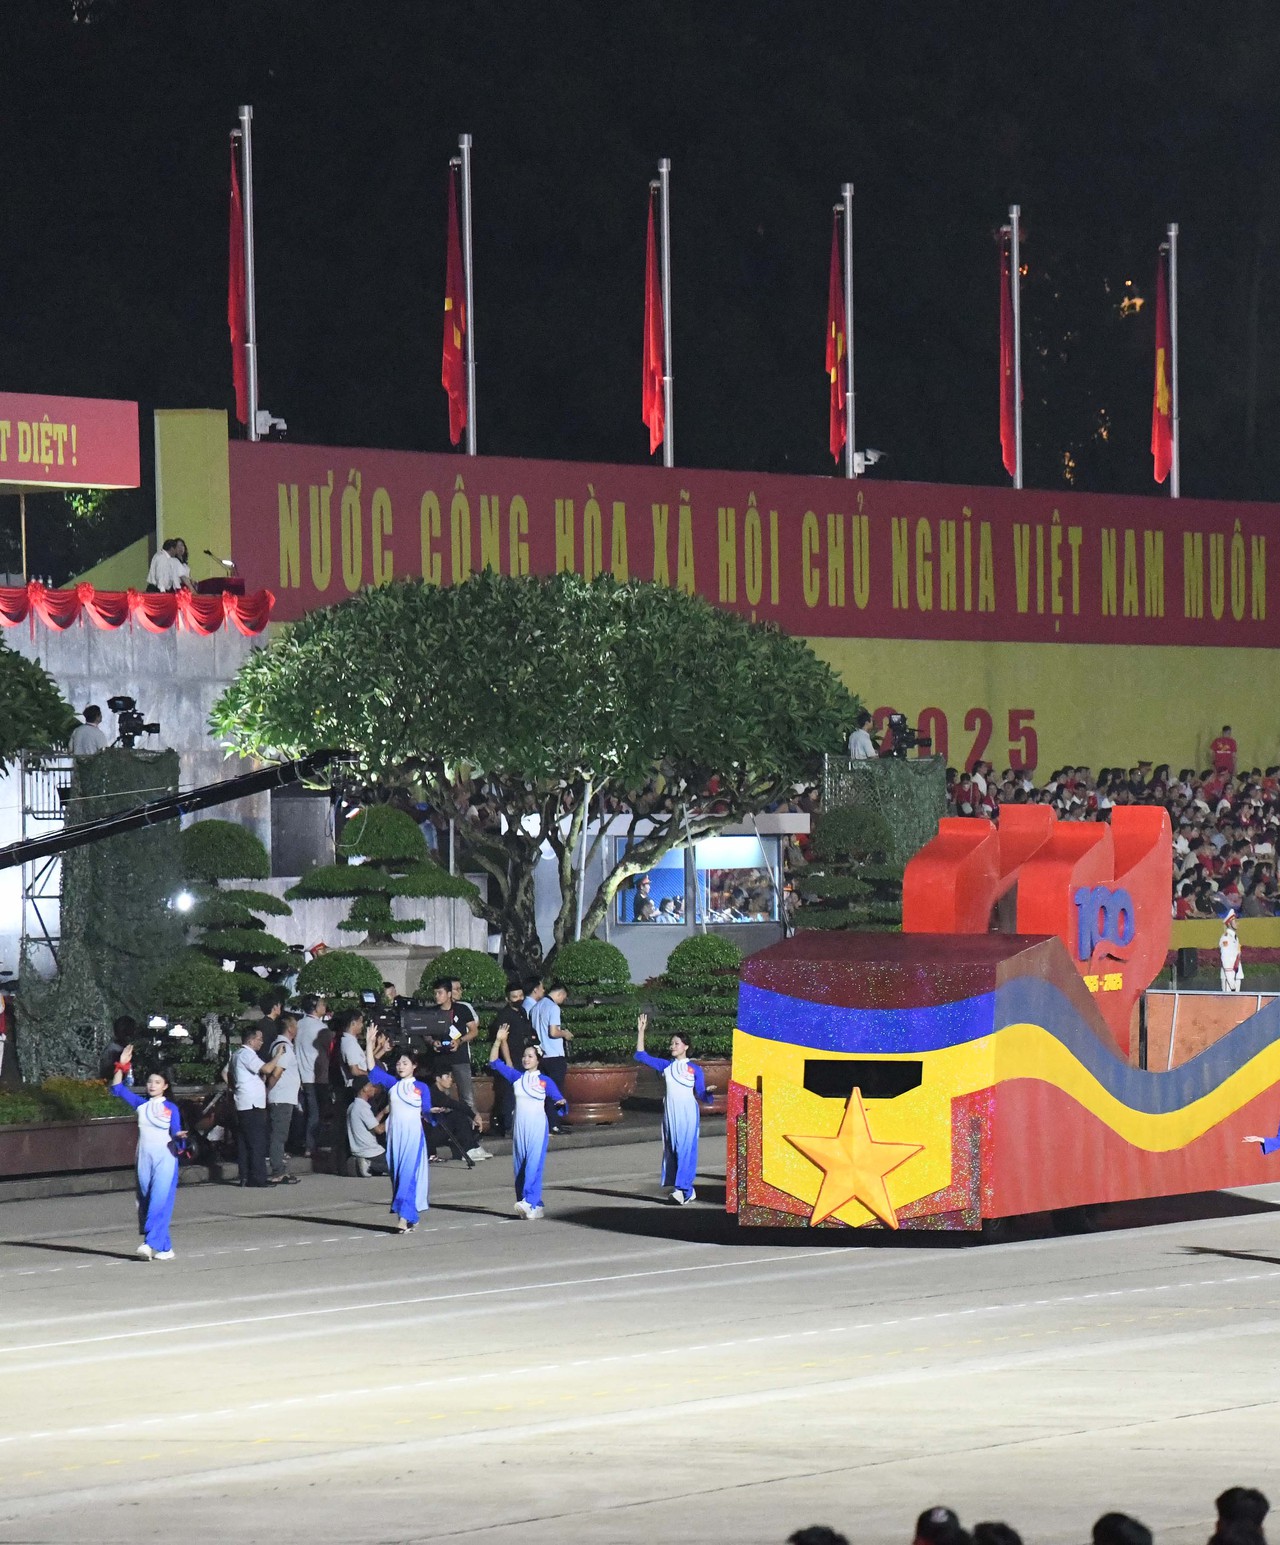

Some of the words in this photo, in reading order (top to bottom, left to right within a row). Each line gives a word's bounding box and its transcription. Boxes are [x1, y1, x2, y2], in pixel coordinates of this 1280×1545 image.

[17, 413, 77, 473] DIỆT!
[277, 468, 394, 592] NƯỚC
[555, 483, 628, 583] HÒA
[652, 489, 695, 596] XÃ
[717, 491, 779, 624] HỘI
[802, 491, 870, 610] CHỦ
[891, 506, 995, 612] NGHĨA
[1013, 508, 1083, 632] VIỆT
[1101, 528, 1164, 617] NAM
[1183, 517, 1266, 621] MUÔN
[1075, 885, 1135, 961] 100
